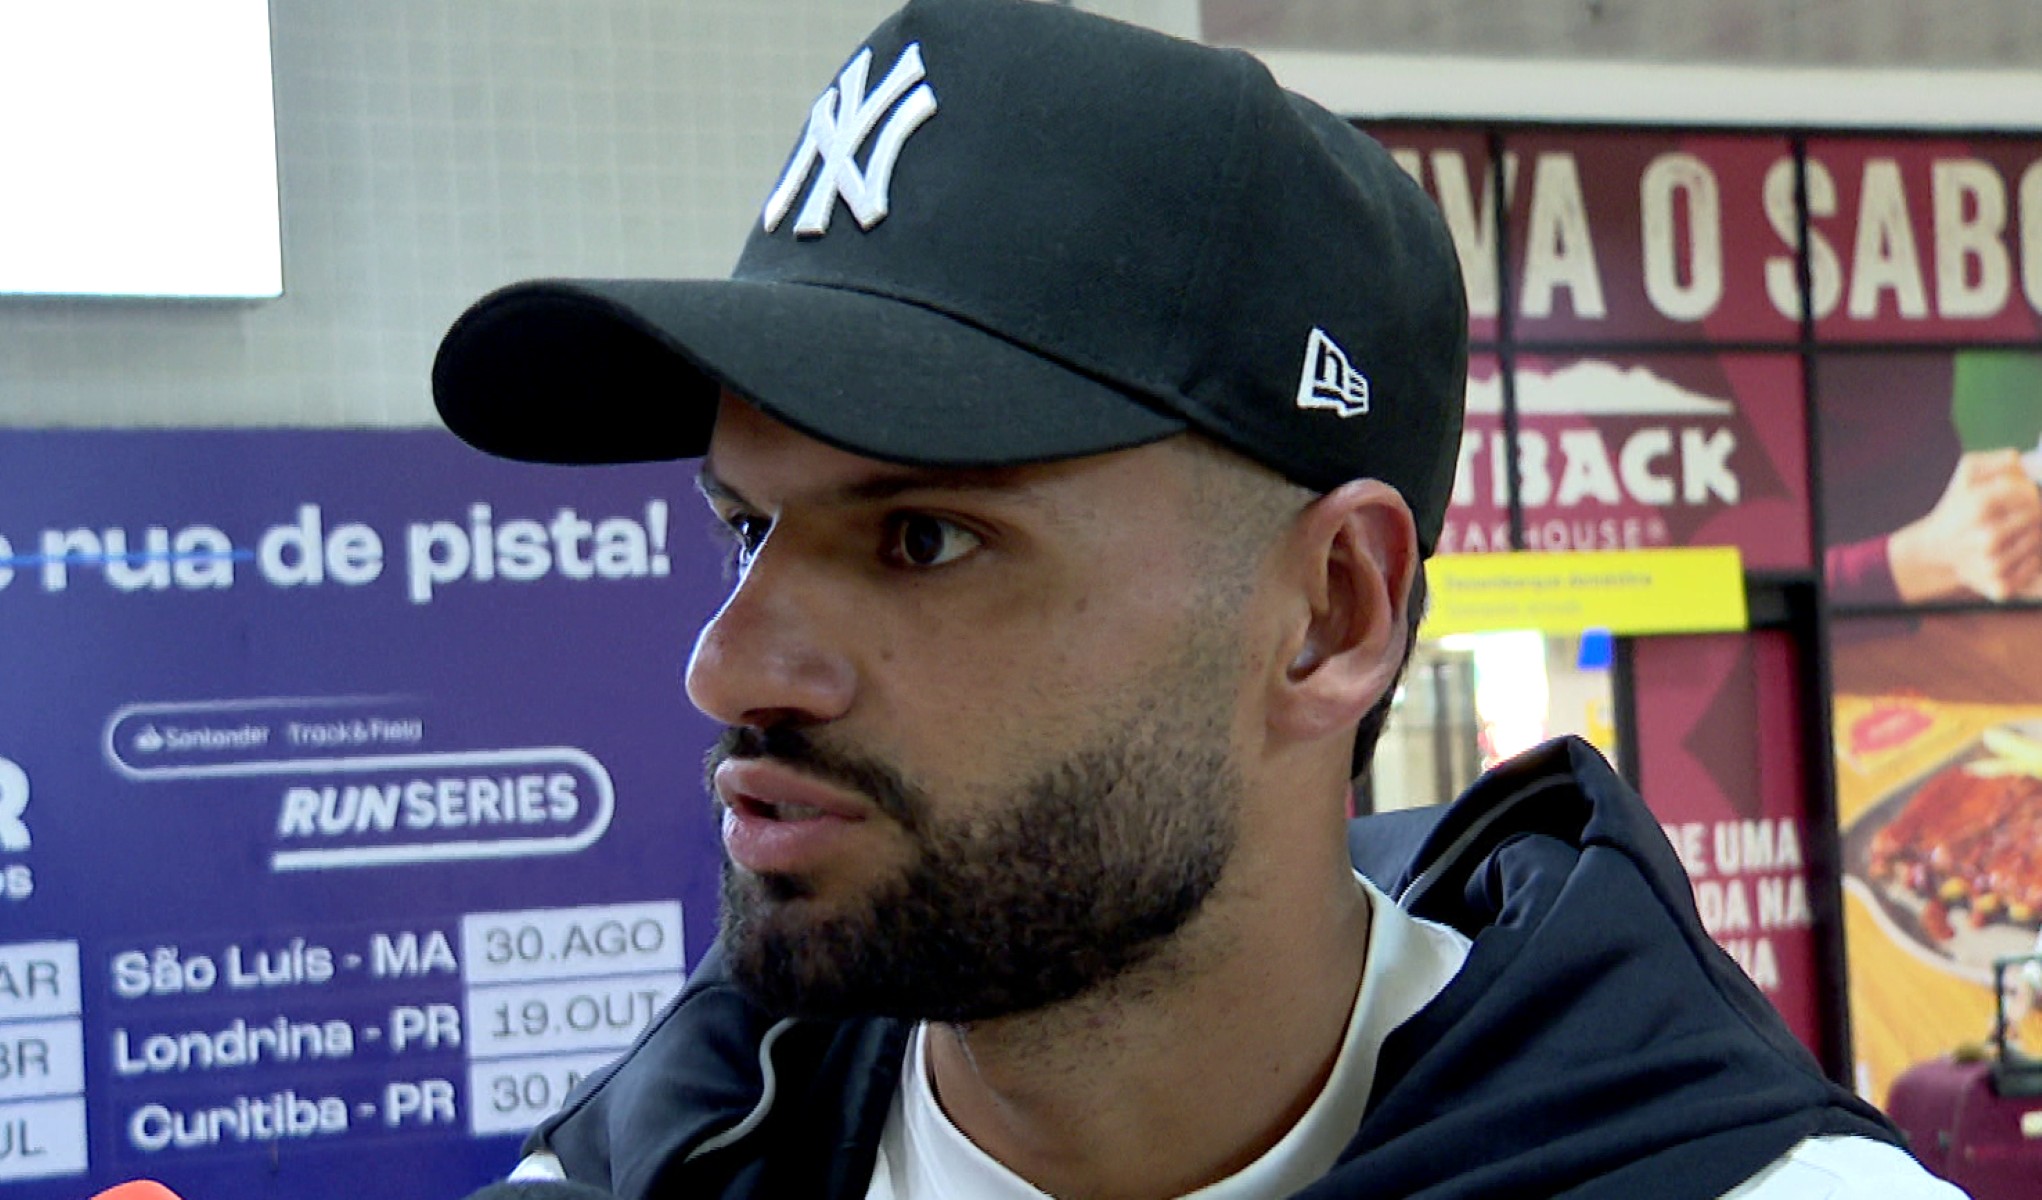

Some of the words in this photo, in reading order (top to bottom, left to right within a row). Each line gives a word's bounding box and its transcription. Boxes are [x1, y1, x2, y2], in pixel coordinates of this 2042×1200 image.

[1640, 152, 1723, 321] O
[42, 524, 235, 592] rua
[257, 502, 384, 587] de
[406, 499, 671, 602] pista!
[1714, 817, 1802, 873] UMA
[111, 945, 217, 997] São
[224, 936, 336, 989] Luís
[370, 930, 459, 978] MA
[486, 918, 664, 964] 30.AGO
[112, 1017, 354, 1075] Londrina
[388, 1003, 463, 1052] PR
[493, 990, 665, 1038] 19.OUT
[128, 1089, 350, 1151] Curitiba
[382, 1078, 457, 1127] PR
